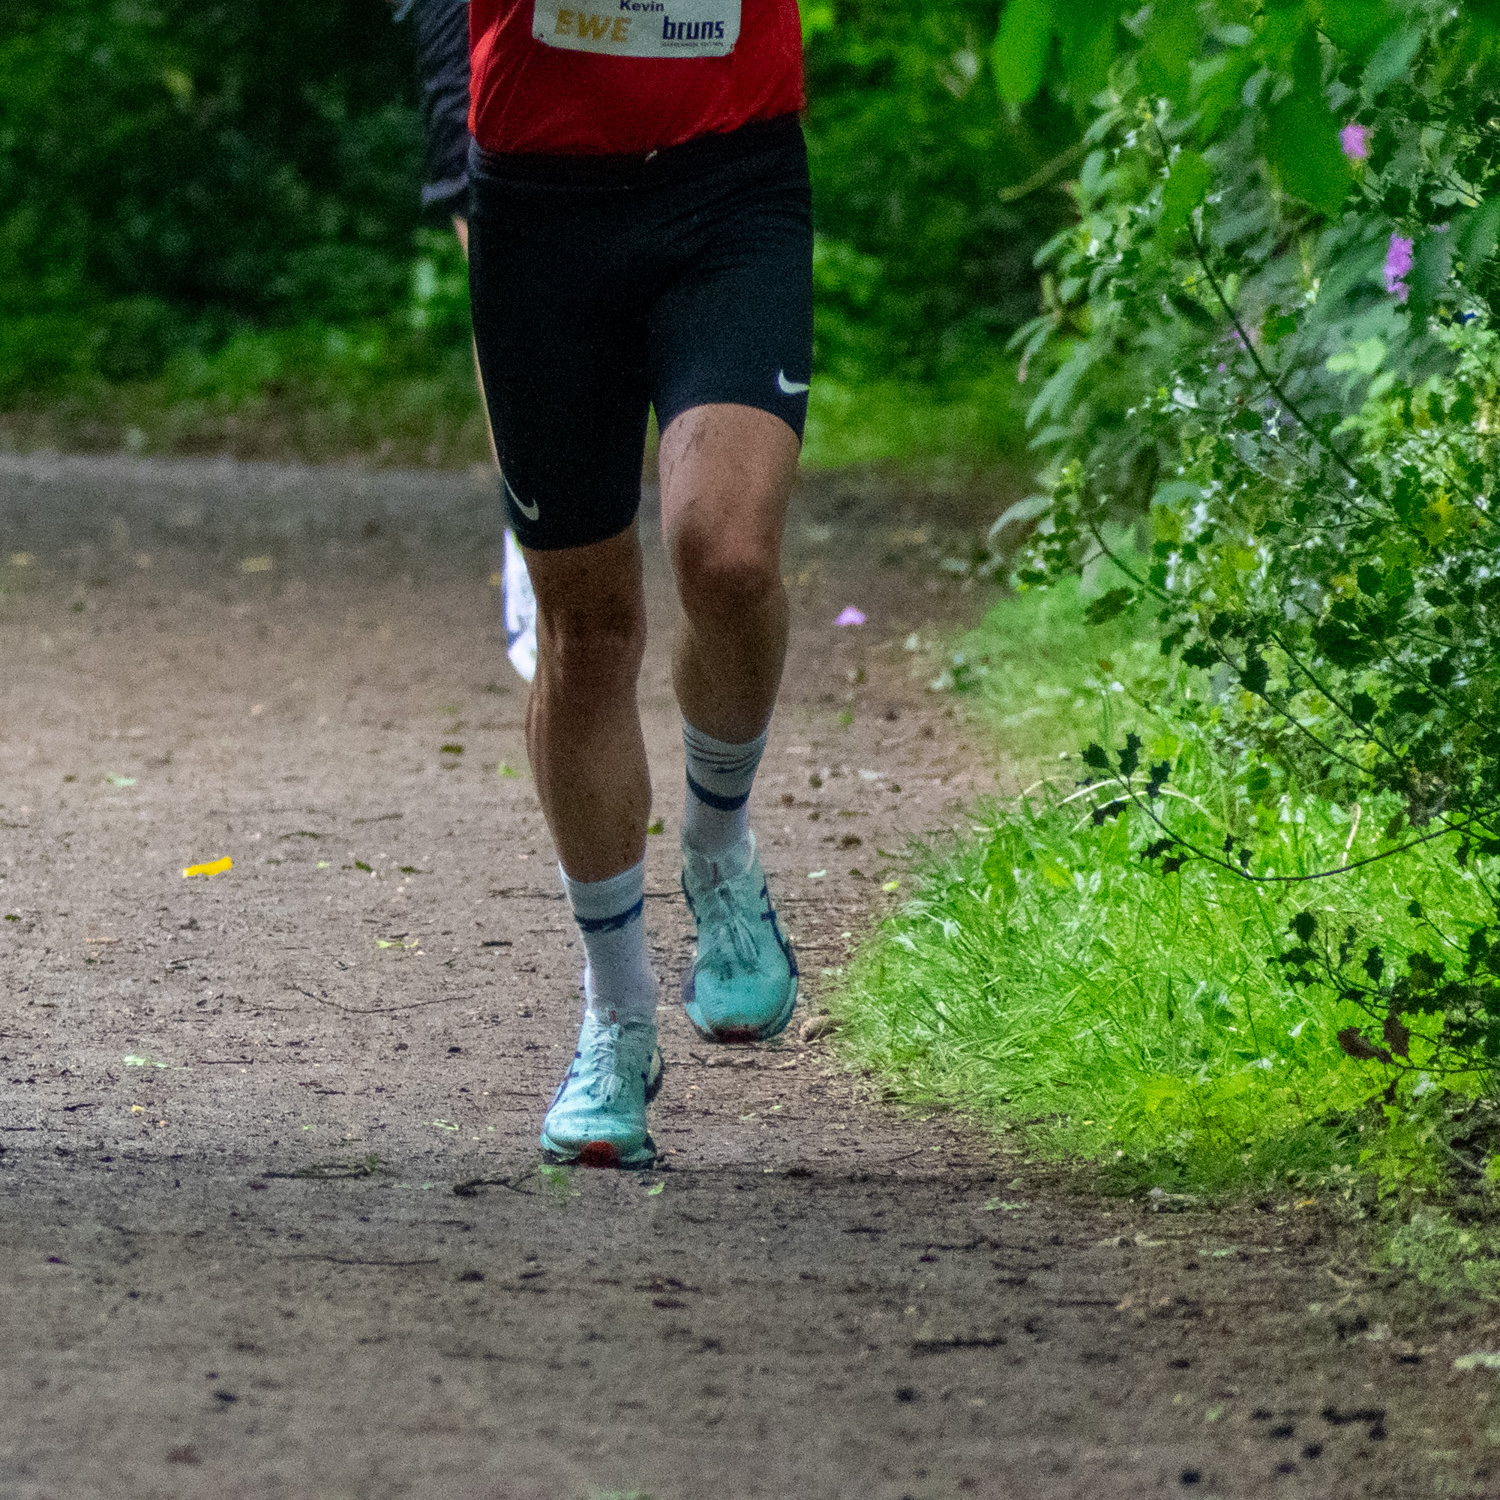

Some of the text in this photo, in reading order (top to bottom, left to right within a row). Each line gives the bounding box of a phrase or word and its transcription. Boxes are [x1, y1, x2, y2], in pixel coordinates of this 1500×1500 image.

[619, 0, 664, 13] Kevin
[555, 9, 632, 42] EWE
[662, 15, 725, 40] bruns
